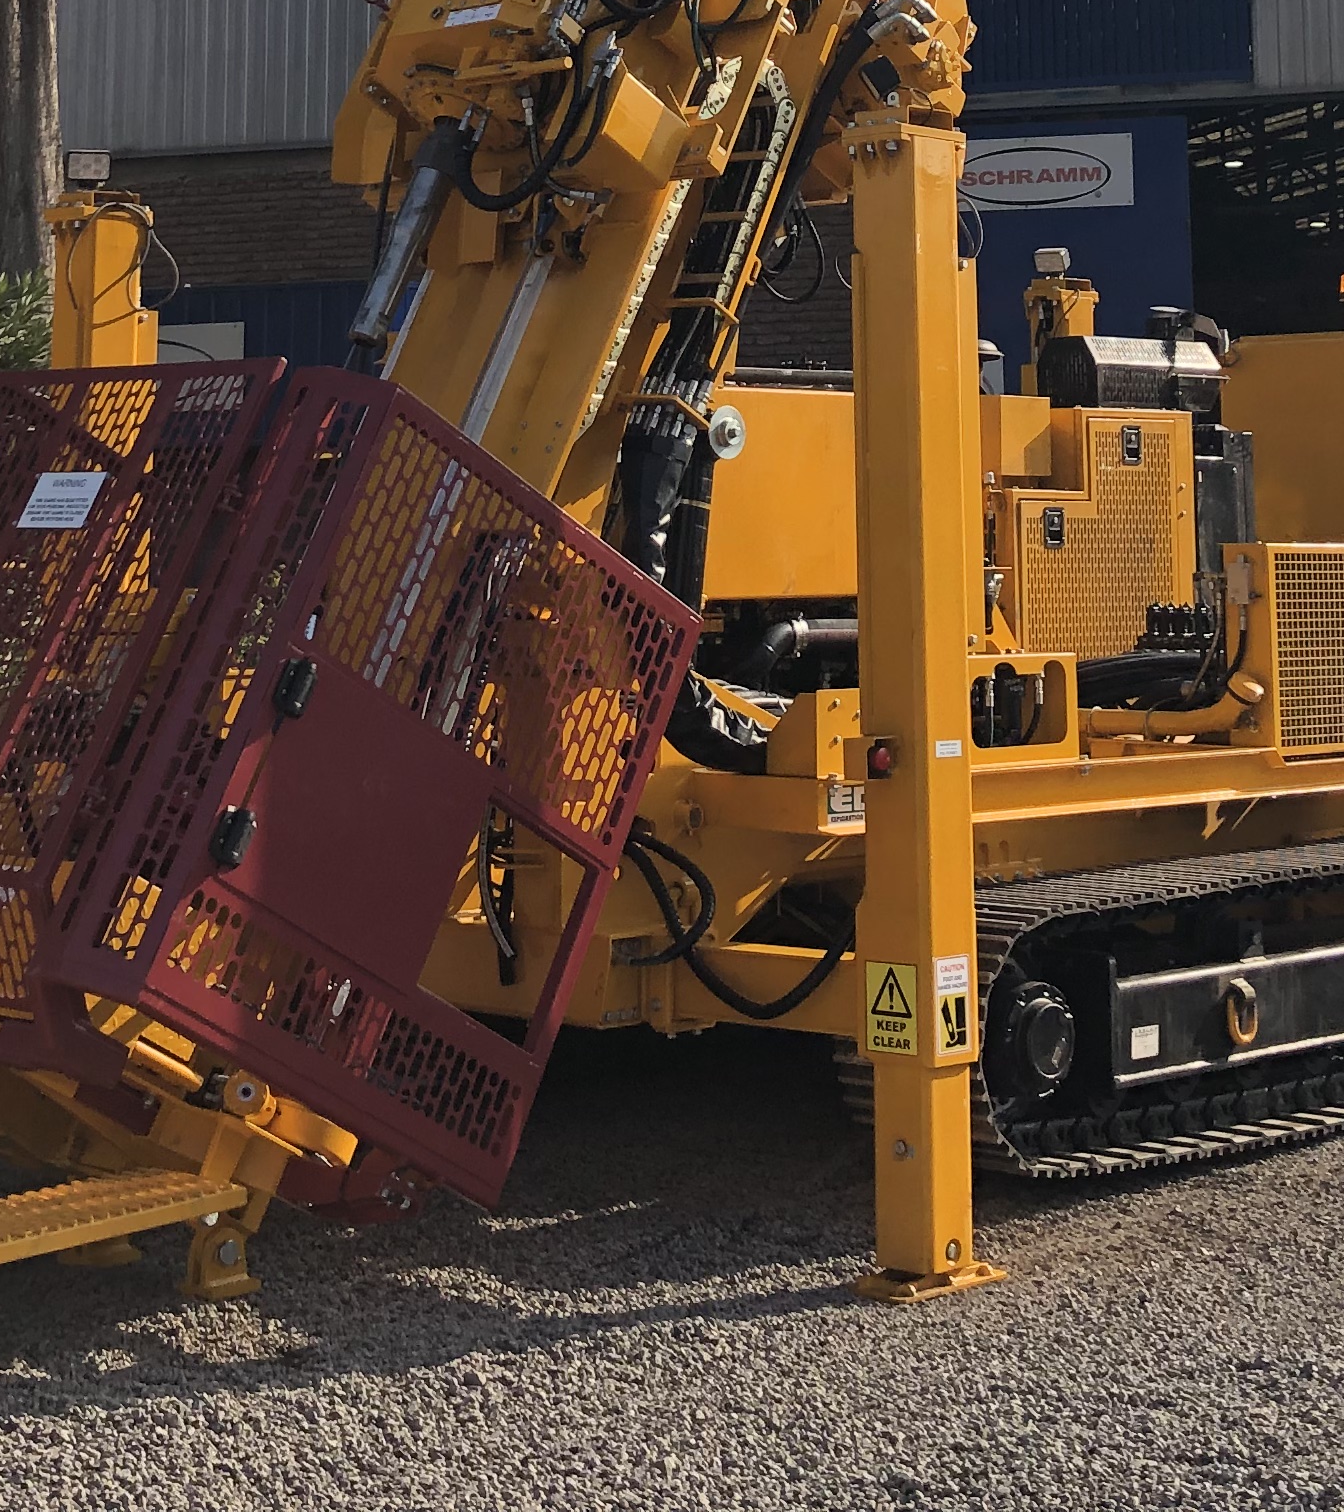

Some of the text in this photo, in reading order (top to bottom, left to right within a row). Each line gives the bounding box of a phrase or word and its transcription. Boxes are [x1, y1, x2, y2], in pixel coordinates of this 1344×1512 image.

[961, 167, 1102, 187] SCHRAMM
[876, 1019, 907, 1032] KEEP
[873, 1036, 911, 1050] CLEAR
